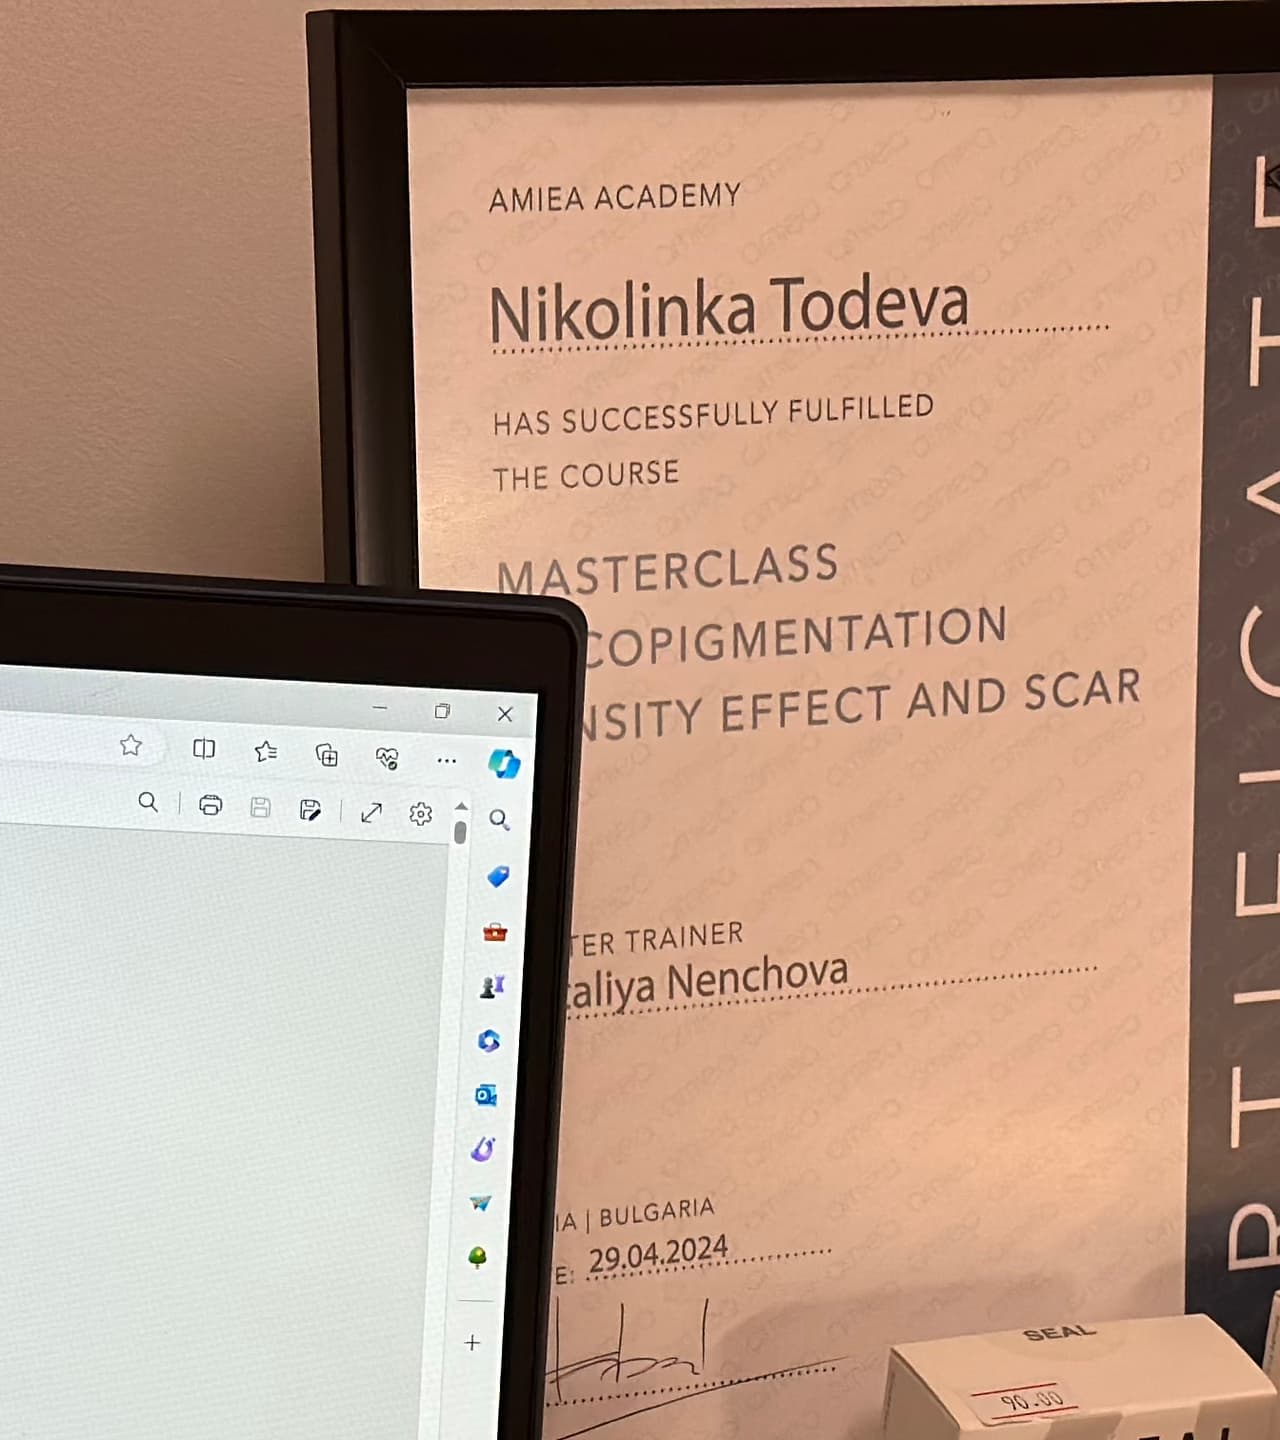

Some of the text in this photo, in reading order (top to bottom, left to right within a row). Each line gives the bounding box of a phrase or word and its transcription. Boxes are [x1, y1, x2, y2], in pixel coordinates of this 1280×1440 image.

[488, 181, 742, 213] AMIEA ACADEMY
[490, 272, 970, 344] Nikolinka Todeva
[492, 393, 935, 437] HAS SUCCESSFULLY FULFILLED
[493, 460, 680, 492] THE COURSE
[496, 542, 839, 597] MASTERCLASS
[722, 684, 891, 733] EFFECT
[906, 677, 1007, 720] AND
[1024, 667, 1142, 711] SCAR
[625, 921, 744, 953] TRAINER
[568, 955, 849, 1014] aliya Nenchova
[600, 1196, 715, 1227] BULGARIA
[589, 1233, 729, 1273] 29.04.2024
[1023, 1324, 1097, 1342] SEAL
[1001, 1391, 1063, 1412] 90.00
